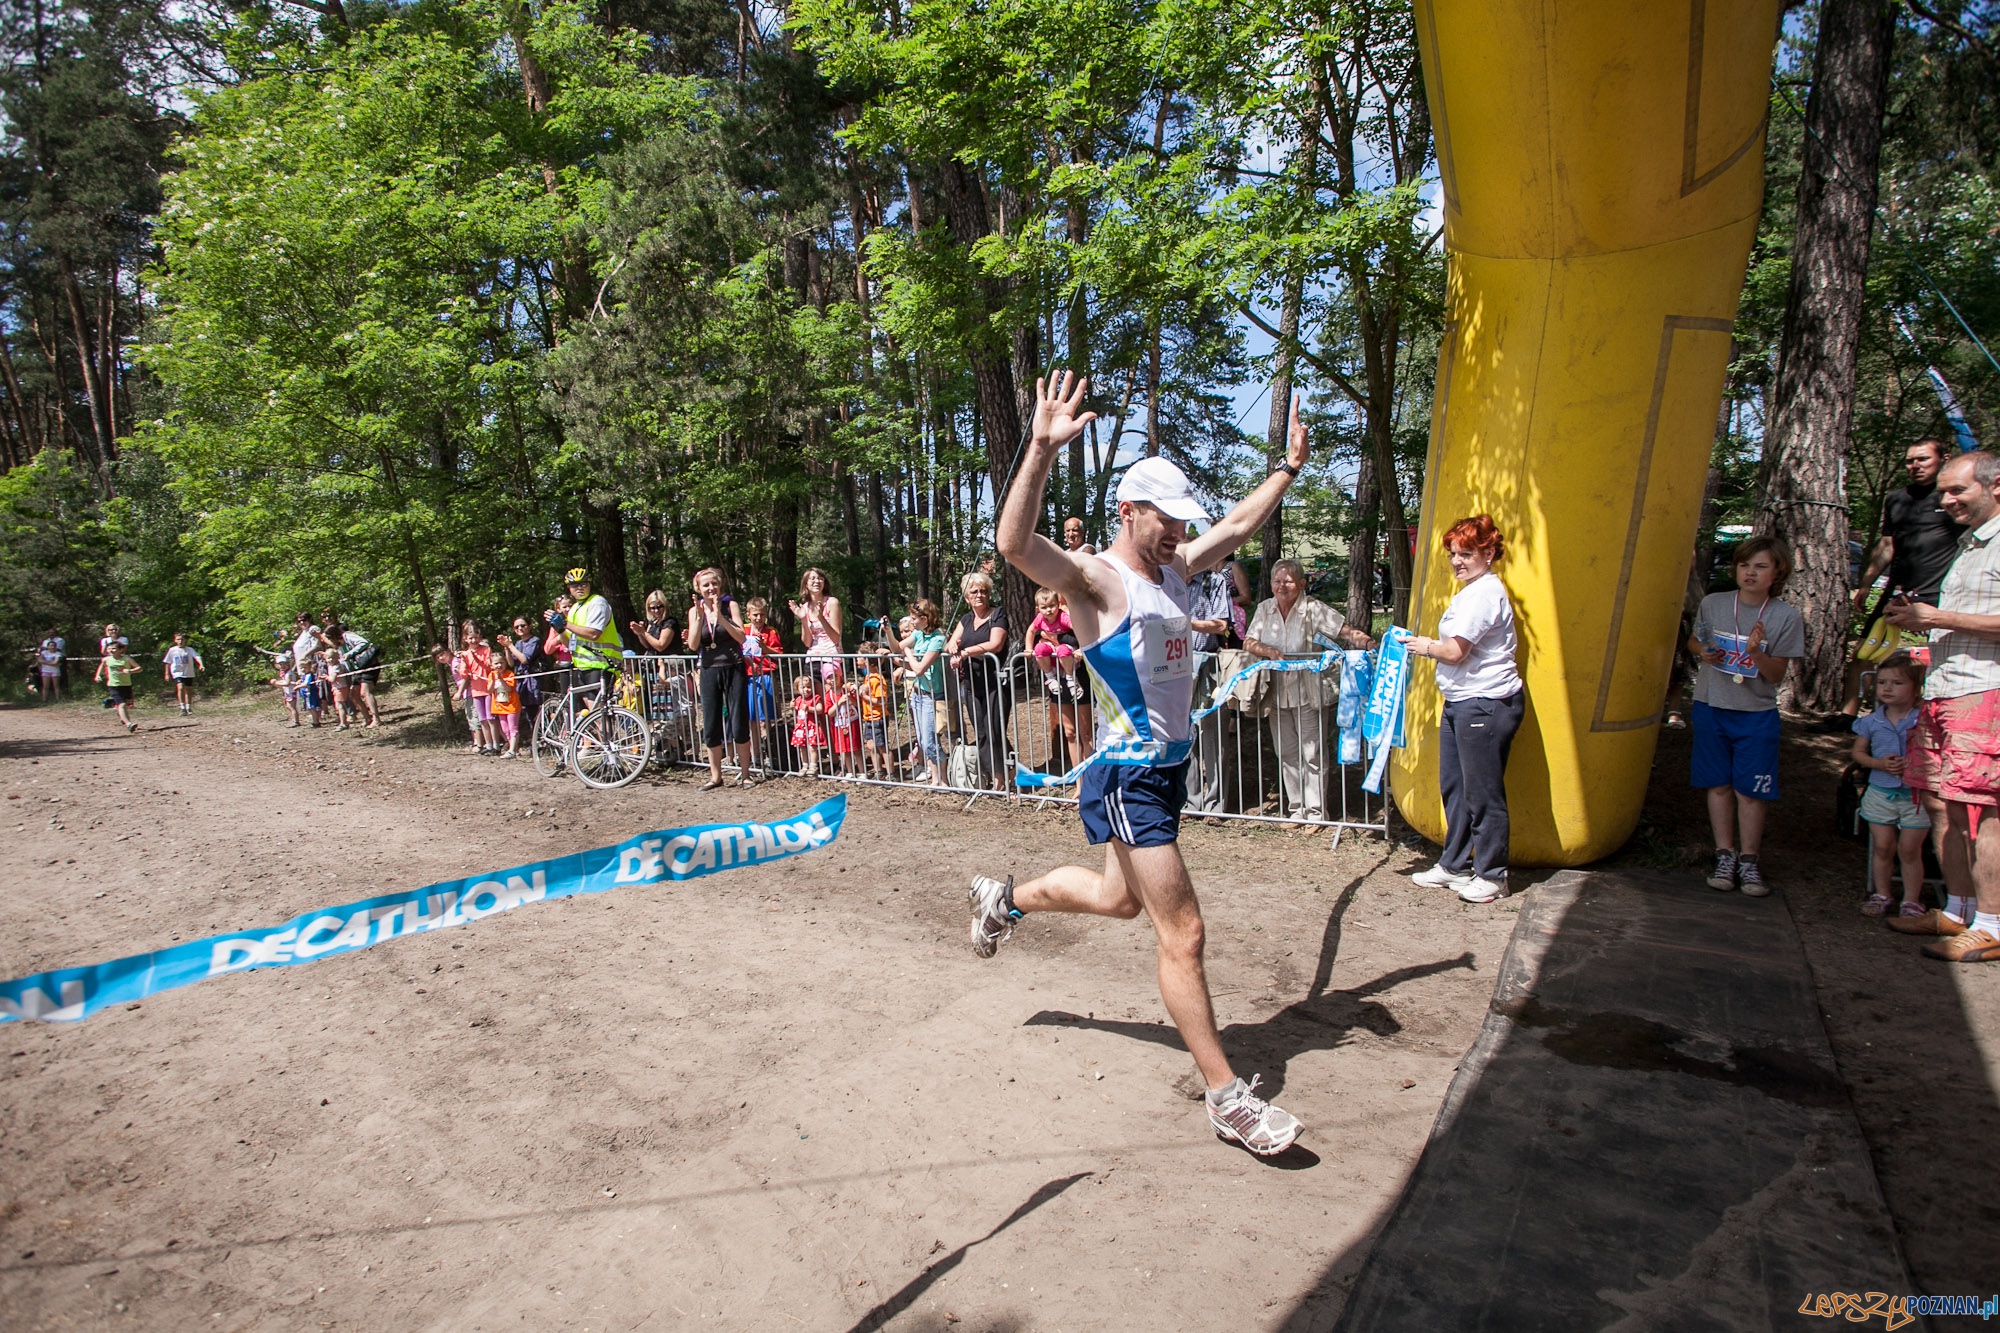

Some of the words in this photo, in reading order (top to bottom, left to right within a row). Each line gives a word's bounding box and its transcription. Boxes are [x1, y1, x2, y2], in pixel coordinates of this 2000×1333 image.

[1165, 637, 1188, 662] 291
[1716, 648, 1755, 669] 274
[1752, 774, 1772, 793] 72
[613, 811, 834, 883] DECATHLON
[207, 869, 547, 976] DECATHLON
